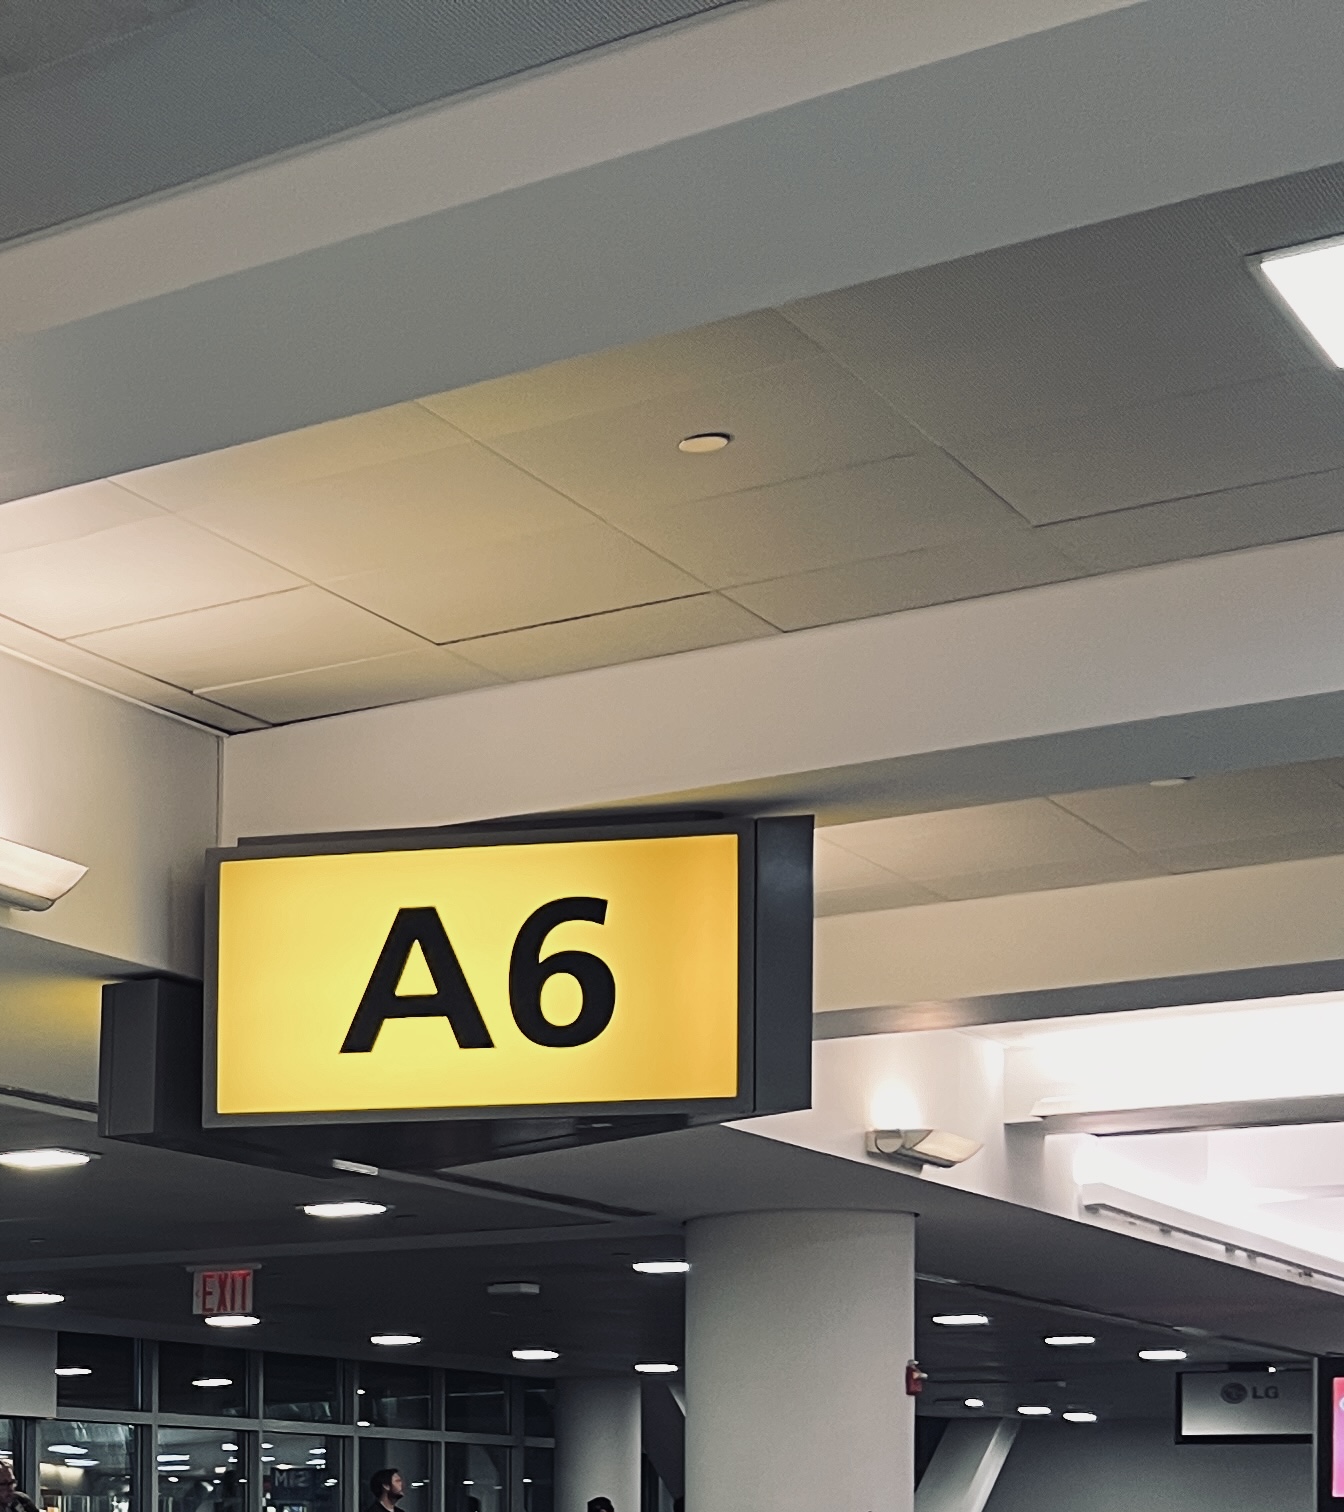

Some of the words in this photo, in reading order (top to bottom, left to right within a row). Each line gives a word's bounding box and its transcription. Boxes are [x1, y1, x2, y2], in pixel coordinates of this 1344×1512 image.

[339, 896, 616, 1054] A6
[201, 1270, 251, 1312] EXIT
[1251, 1386, 1280, 1399] LG
